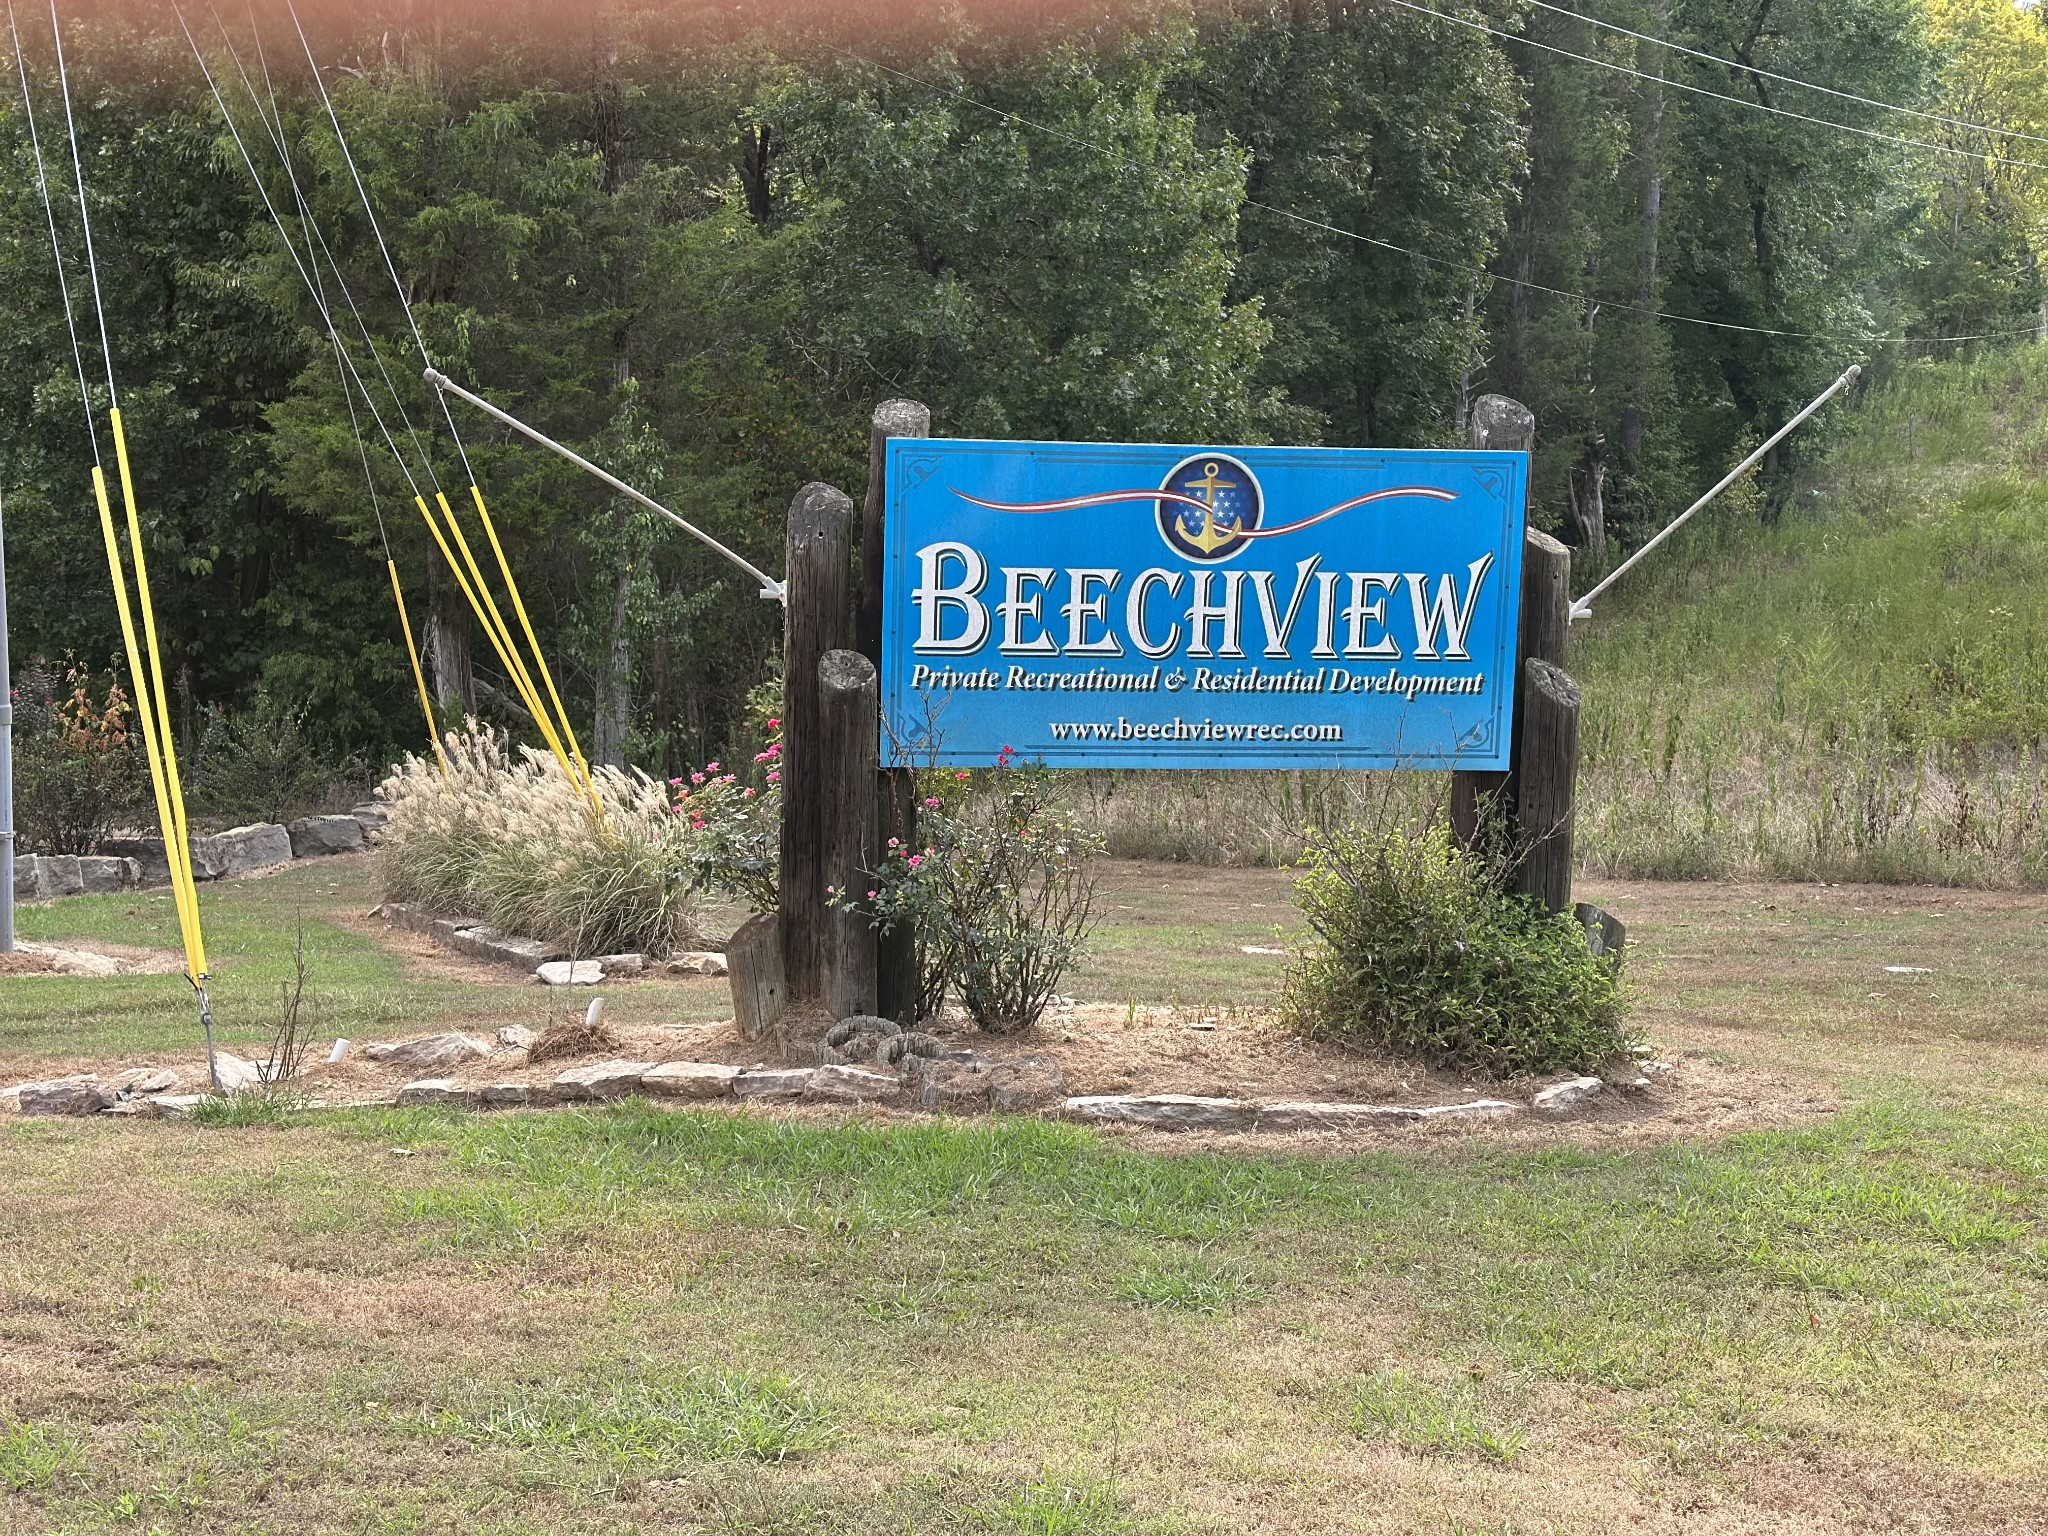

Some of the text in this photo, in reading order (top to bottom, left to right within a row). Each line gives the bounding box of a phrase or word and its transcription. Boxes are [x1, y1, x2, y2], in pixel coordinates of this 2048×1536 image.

[911, 541, 1494, 661] BEECHVIEW
[911, 664, 1484, 701] Private Recreational & Residential Development
[1050, 717, 1343, 742] www.beechviewrec.com
